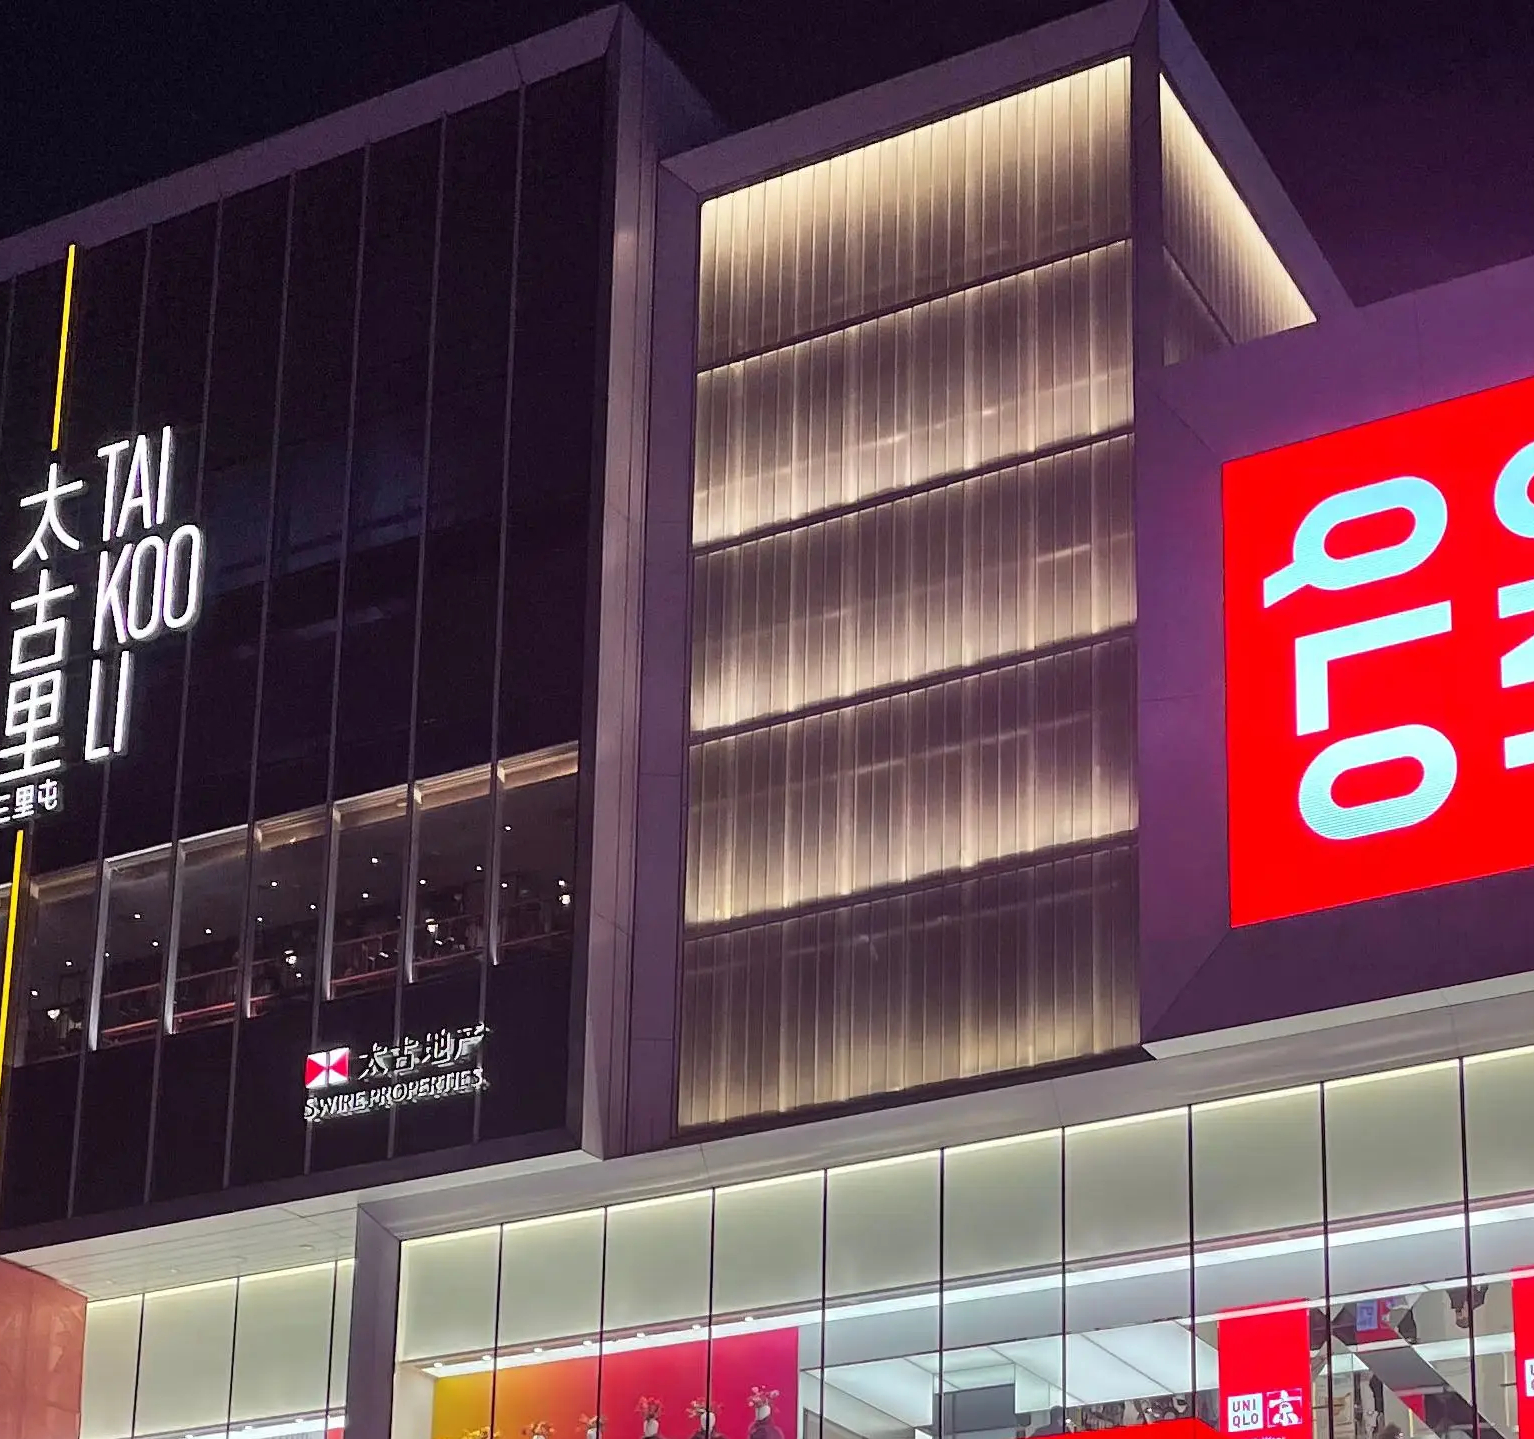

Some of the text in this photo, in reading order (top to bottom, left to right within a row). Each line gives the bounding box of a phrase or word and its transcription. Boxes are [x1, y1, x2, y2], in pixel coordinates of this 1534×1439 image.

[97, 425, 173, 542] TAI
[92, 523, 203, 652] KOO
[1263, 475, 1458, 840] QLO
[84, 650, 134, 762] LI
[304, 1065, 491, 1123] SWIRE PROPERTIES
[357, 1021, 492, 1083] 太古地产
[1232, 1398, 1257, 1413] UNI
[1232, 1412, 1259, 1429] QLO
